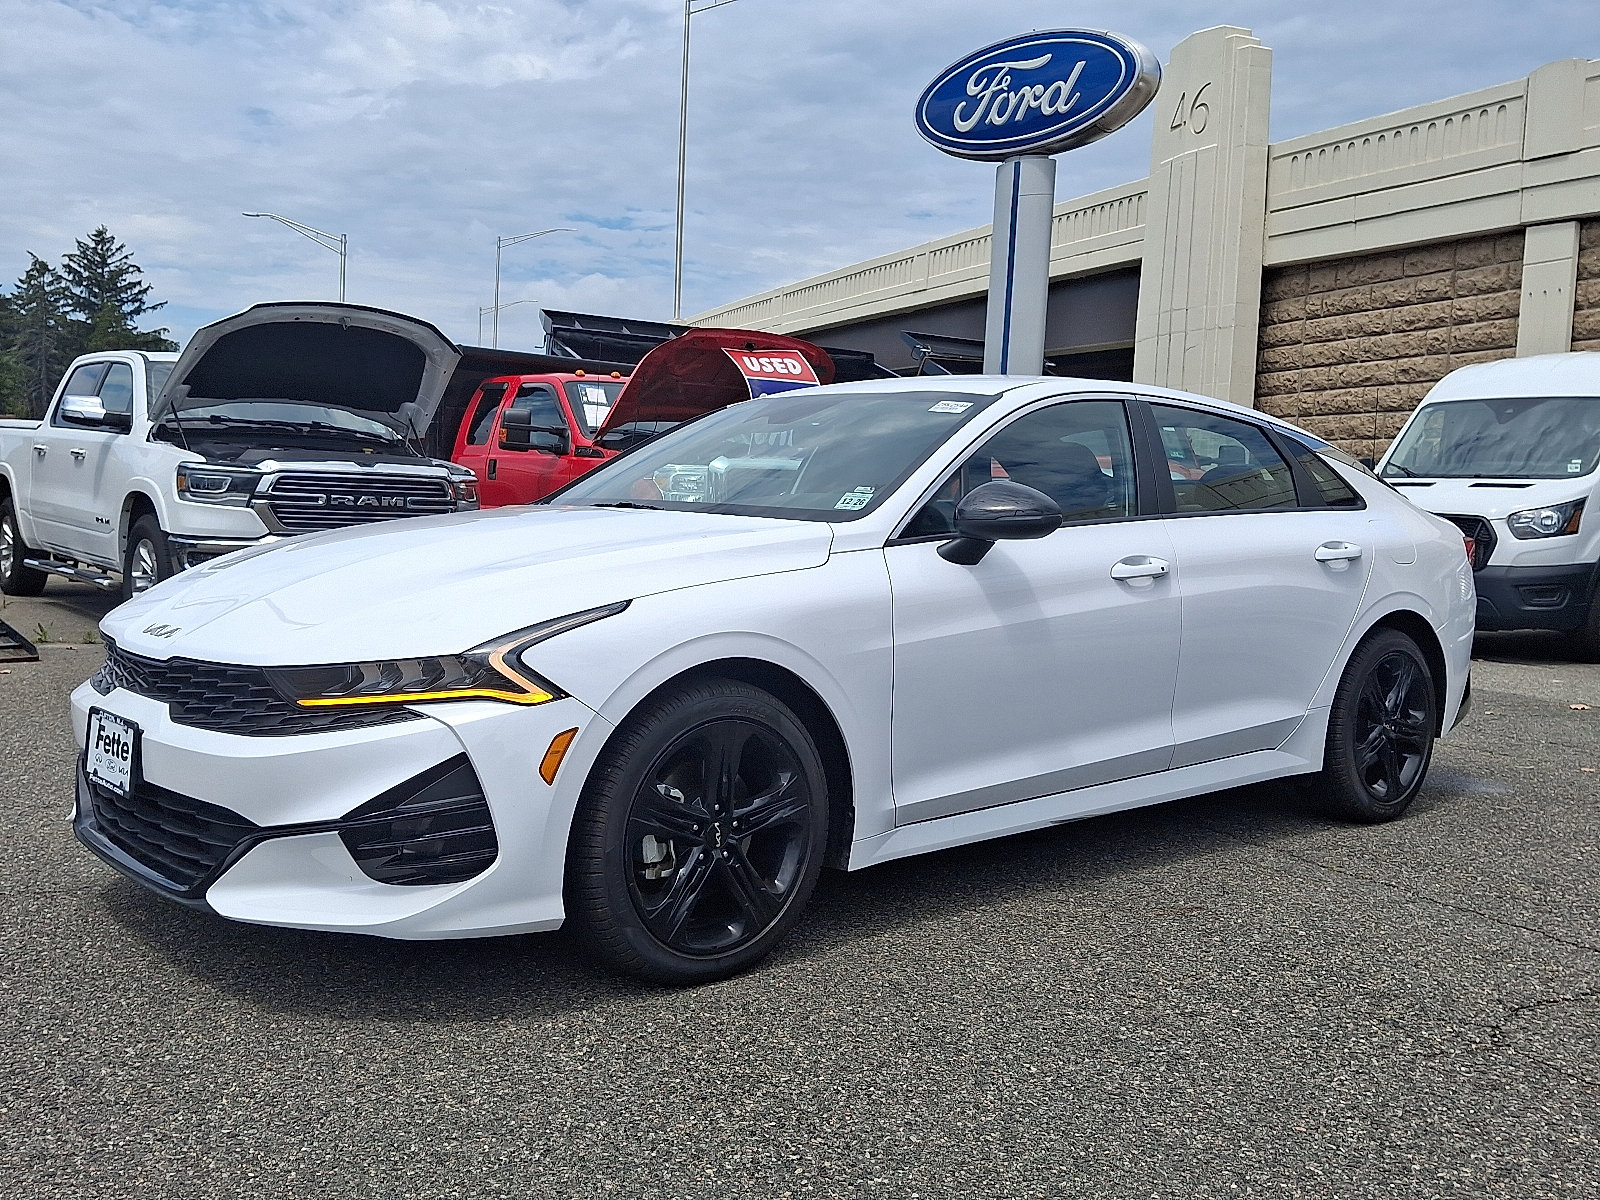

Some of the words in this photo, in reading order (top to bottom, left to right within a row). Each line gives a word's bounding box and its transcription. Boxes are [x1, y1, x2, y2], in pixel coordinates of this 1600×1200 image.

[953, 53, 1087, 133] Ford
[1170, 81, 1212, 136] 46
[741, 356, 802, 375] USED
[330, 494, 404, 507] RAM
[840, 497, 853, 505] 12
[853, 498, 866, 506] 26
[95, 723, 130, 762] Fette
